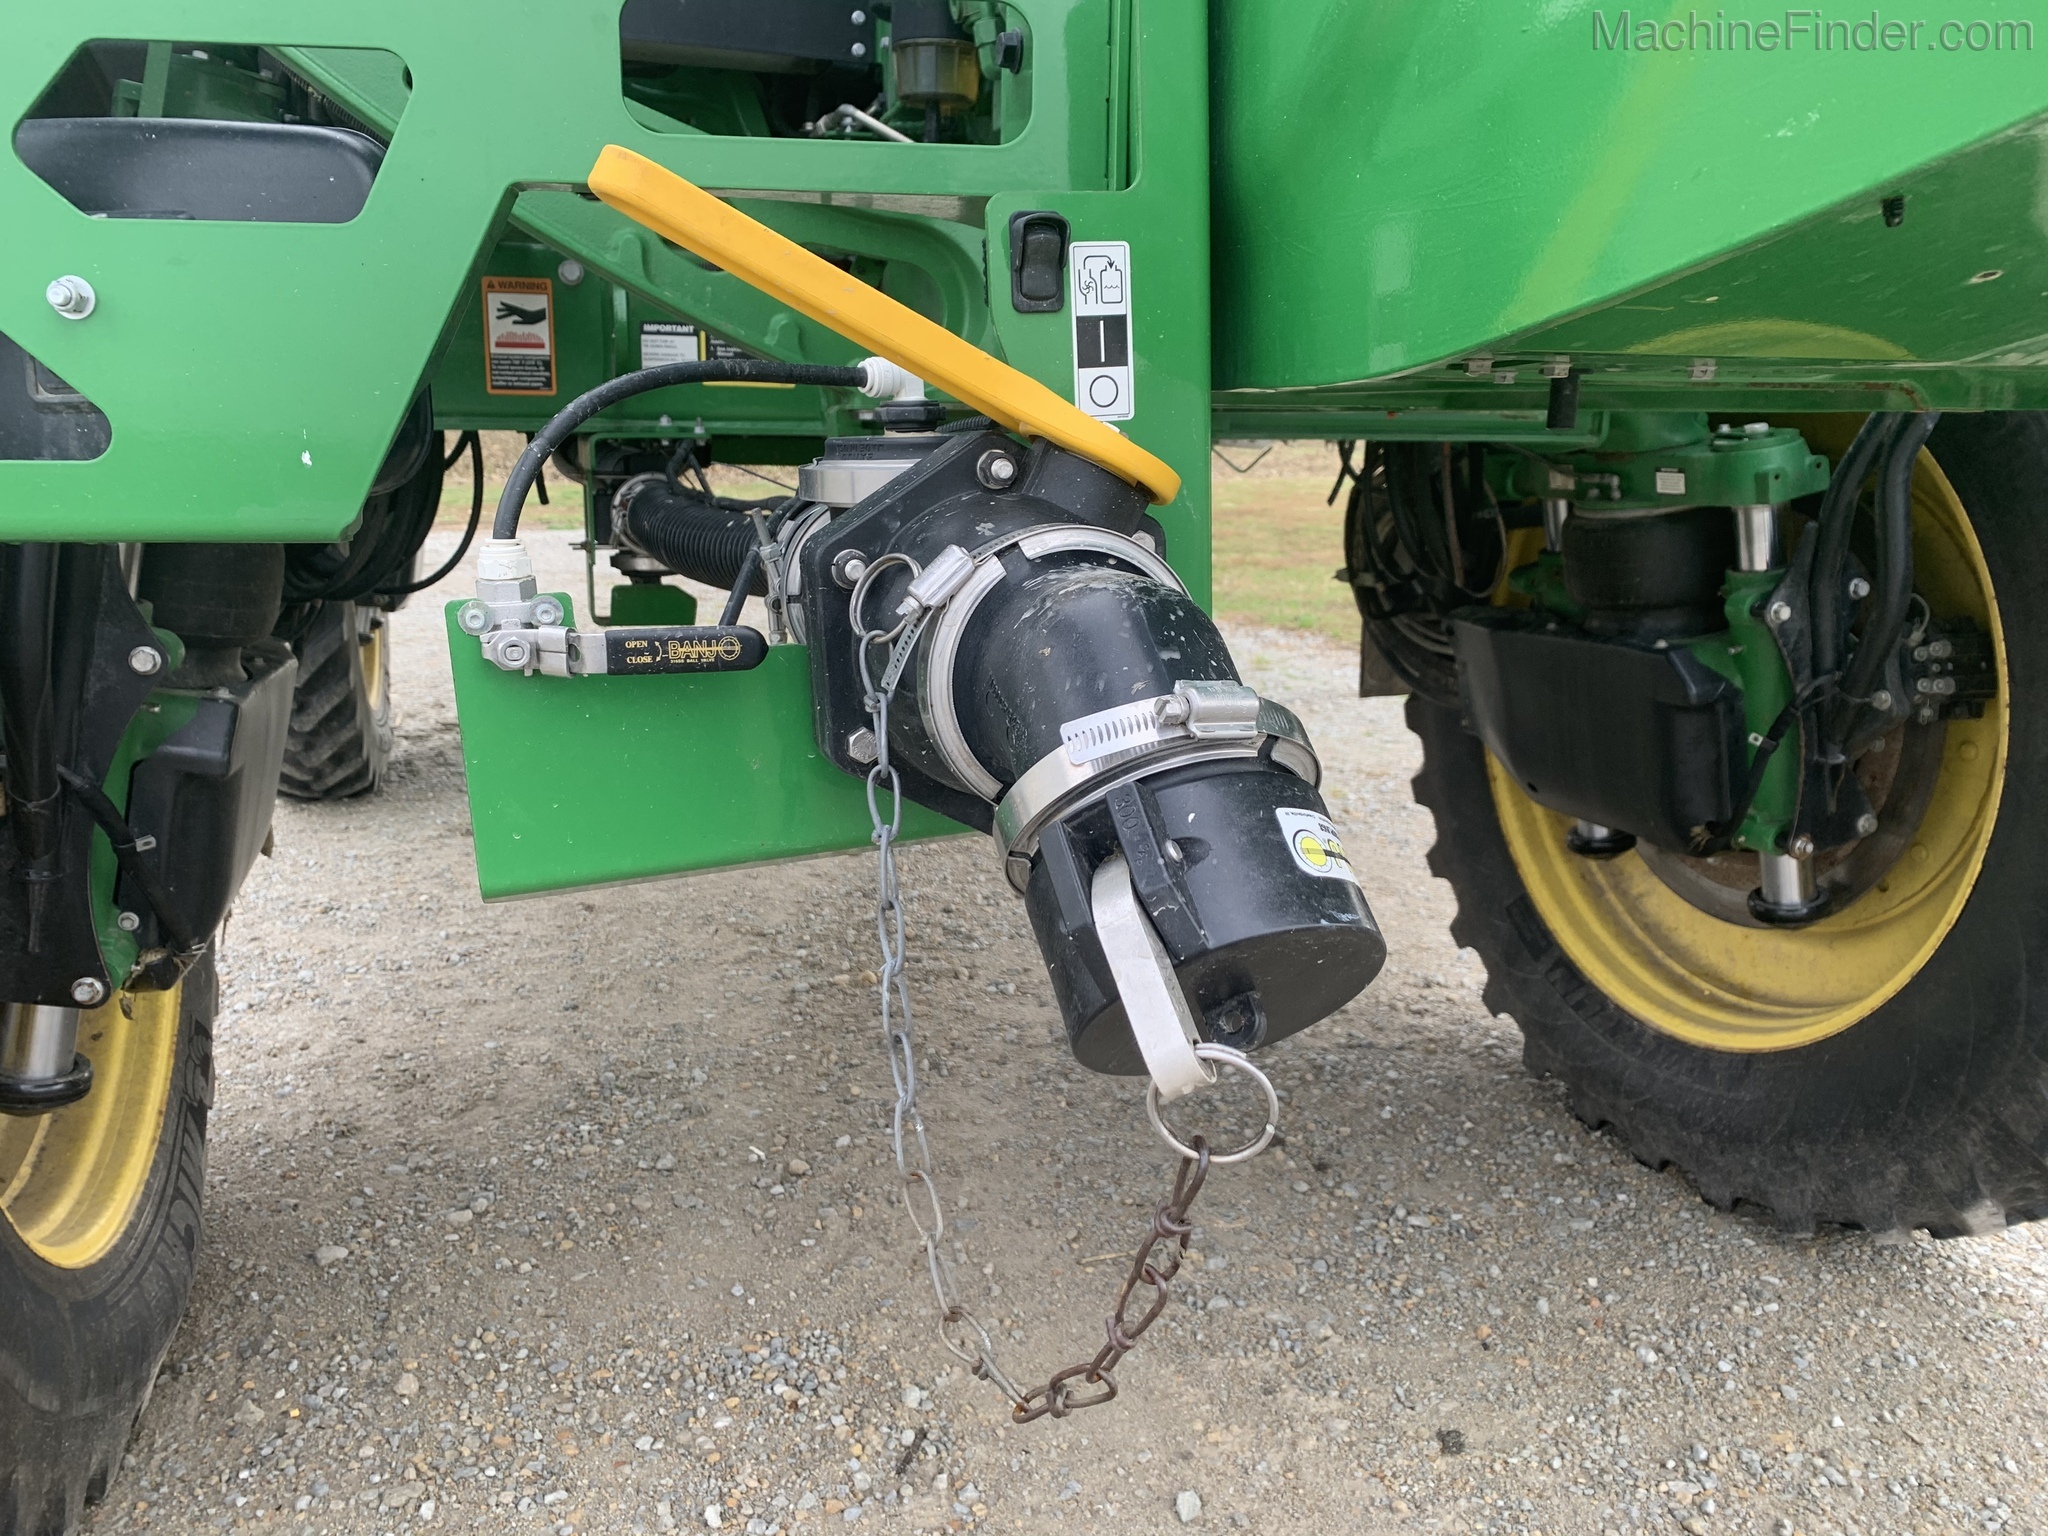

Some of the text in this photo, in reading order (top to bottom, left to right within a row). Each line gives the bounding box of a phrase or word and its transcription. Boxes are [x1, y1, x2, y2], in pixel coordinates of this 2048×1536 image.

[498, 281, 548, 290] WARNING
[643, 323, 695, 333] IMPORTANT
[625, 640, 648, 649] OPEN
[668, 635, 741, 661] BANJO
[626, 655, 653, 664] CLOSE
[1114, 793, 1140, 830] 300
